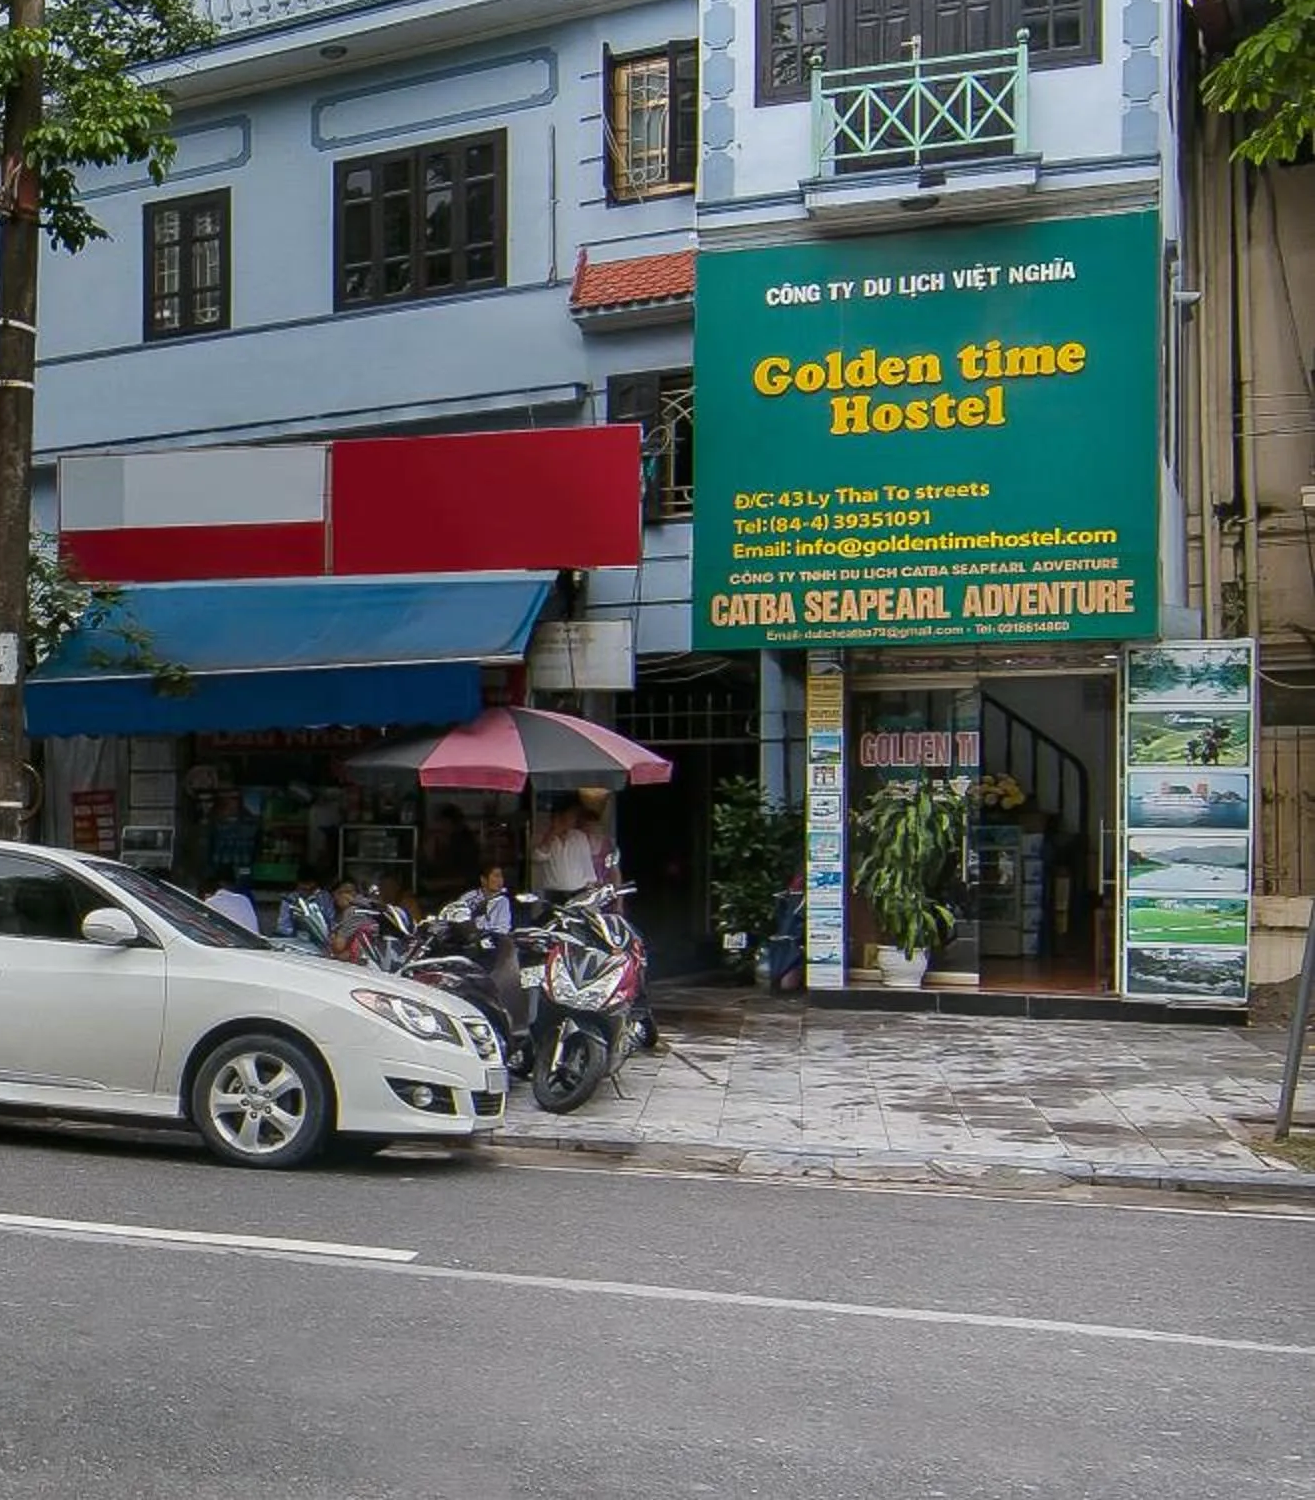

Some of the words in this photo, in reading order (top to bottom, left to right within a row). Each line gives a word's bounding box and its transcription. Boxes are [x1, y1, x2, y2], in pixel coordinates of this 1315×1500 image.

[765, 283, 821, 305] CÔNG
[827, 282, 855, 300] TY
[863, 278, 891, 296] DU
[899, 273, 945, 297] LỊCH
[953, 264, 1001, 290] VIỆT
[1009, 258, 1075, 284] NGHĨA
[753, 348, 942, 397] Golden
[956, 339, 1086, 381] time
[829, 385, 1006, 435] Hostel
[778, 492, 803, 506] 43
[806, 491, 830, 509] Ly
[883, 486, 910, 500] To
[915, 483, 989, 500] streets
[833, 510, 930, 529] 39351091
[733, 541, 791, 559] Email:
[795, 527, 1118, 559] info@goldentimehostel.com
[778, 572, 795, 582] TY
[840, 570, 860, 580] DU
[901, 566, 949, 577] CATBA
[952, 562, 1026, 575] SEAPEARL
[1032, 558, 1118, 572] ADVENTURE
[712, 592, 796, 626] CATBA
[804, 586, 951, 622] SEAPEARL
[962, 580, 1134, 617] ADVENTURE
[861, 731, 952, 767] GOLDEN
